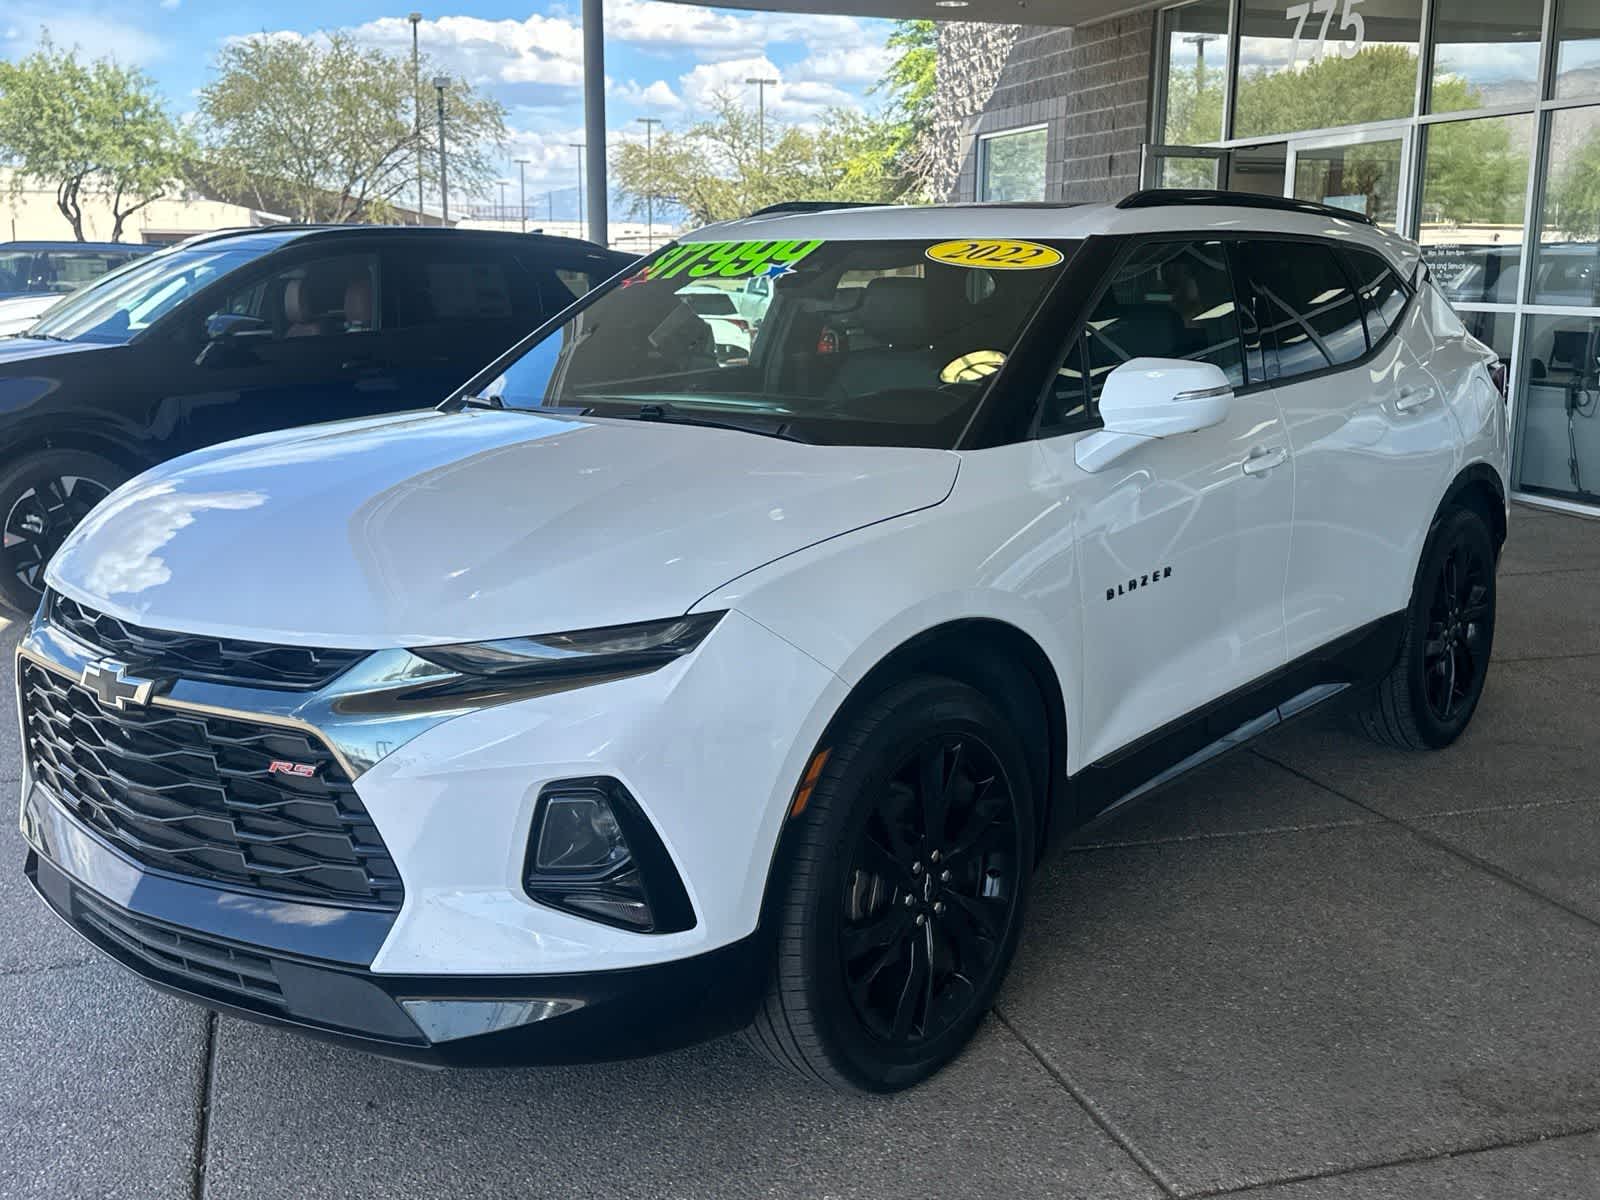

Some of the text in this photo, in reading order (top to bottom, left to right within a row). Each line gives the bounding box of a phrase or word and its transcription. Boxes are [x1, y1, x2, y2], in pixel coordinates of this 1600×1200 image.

[1286, 0, 1365, 72] 775
[942, 243, 1044, 263] 2022
[1106, 566, 1172, 601] BLAZER
[268, 761, 316, 778] RS
